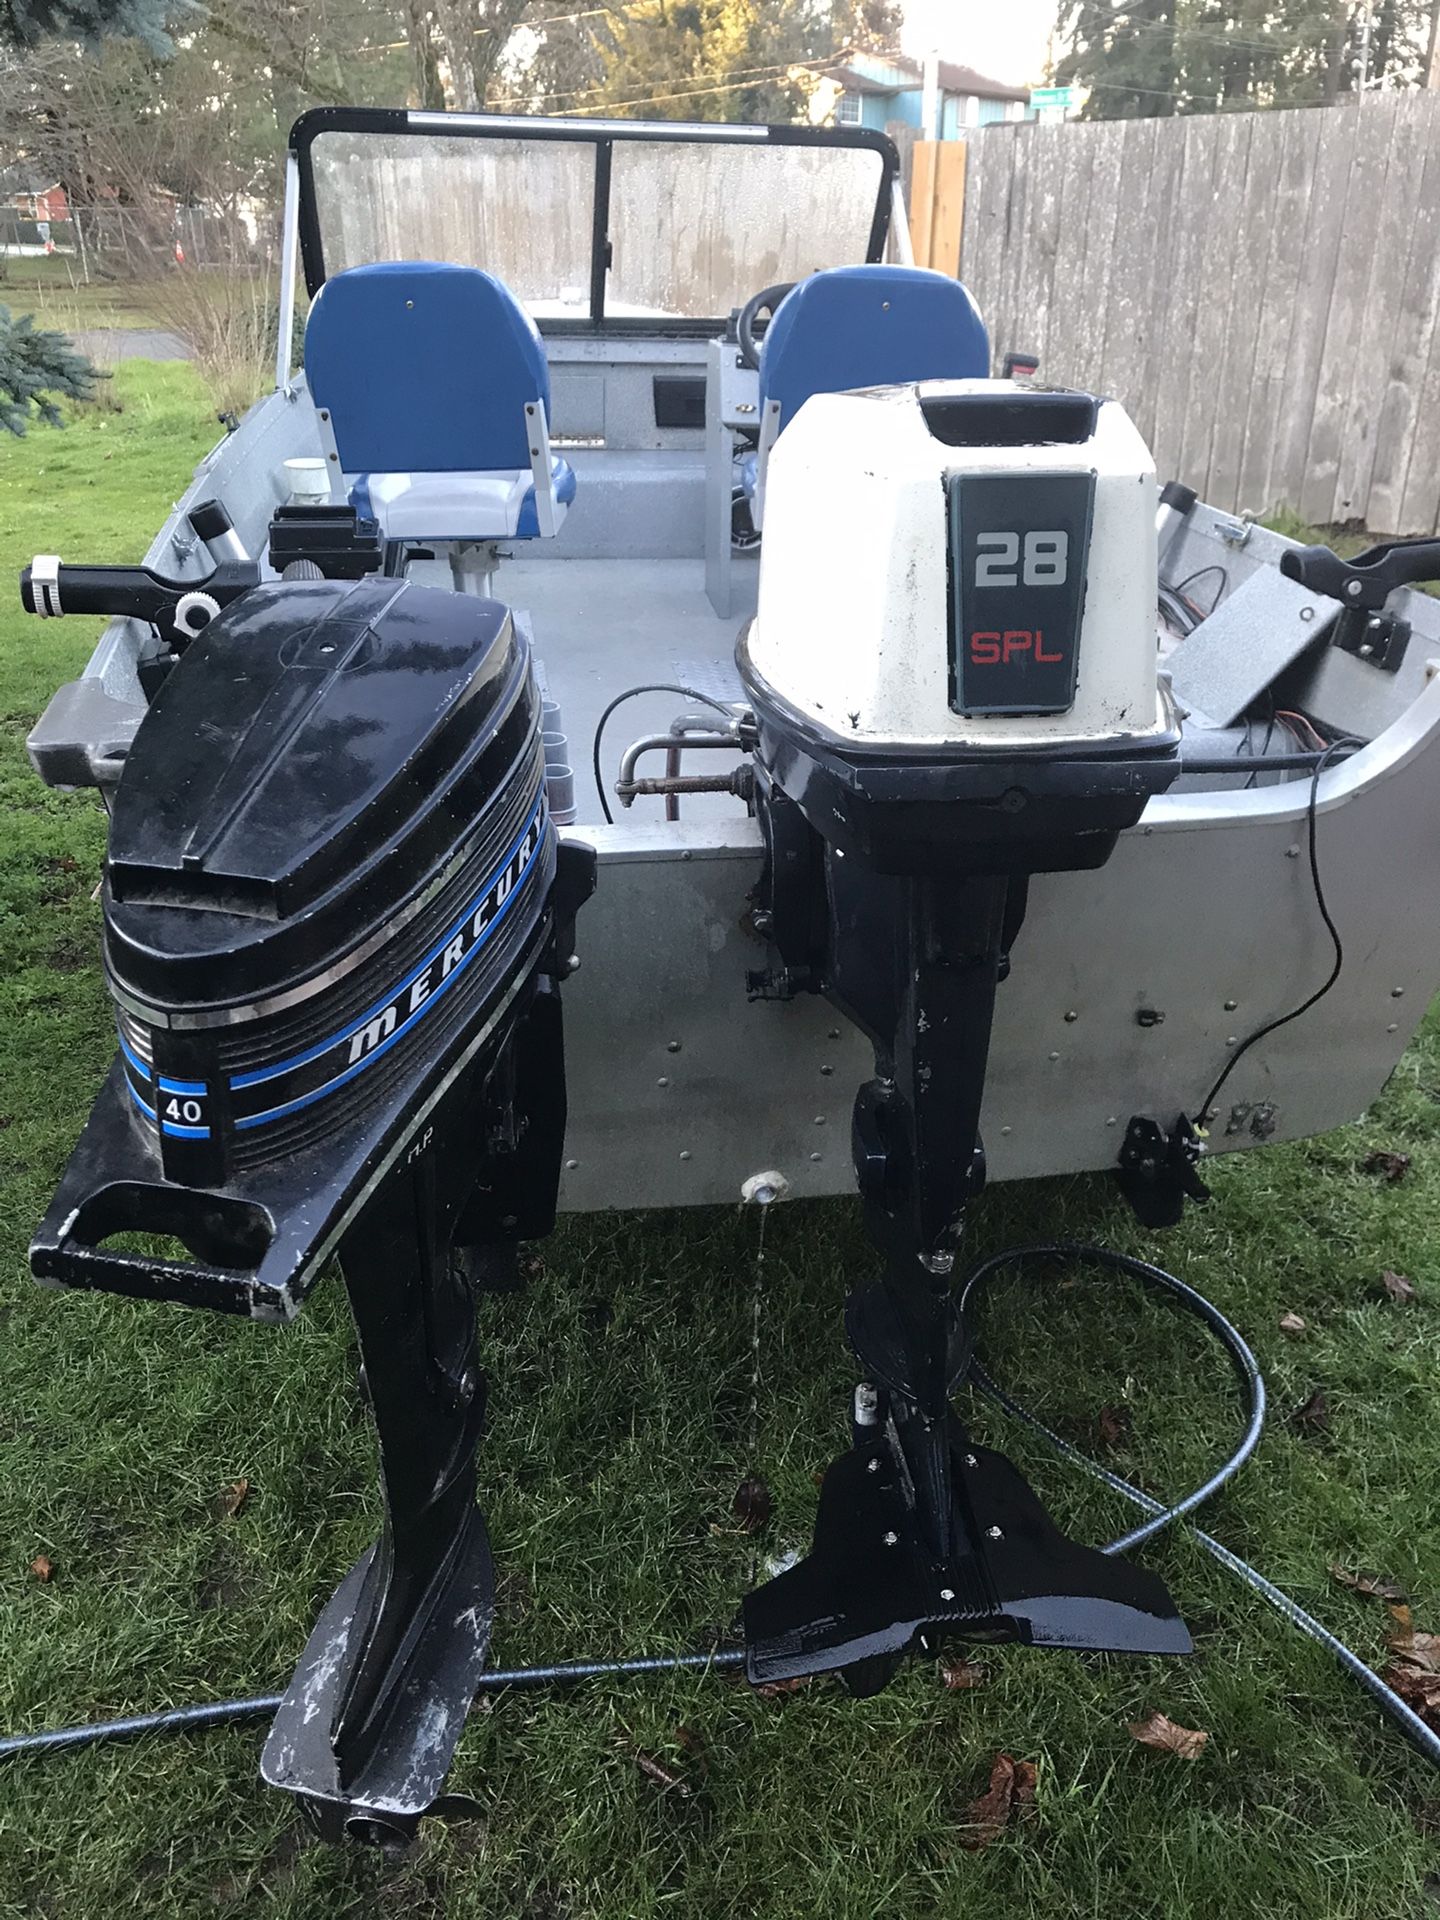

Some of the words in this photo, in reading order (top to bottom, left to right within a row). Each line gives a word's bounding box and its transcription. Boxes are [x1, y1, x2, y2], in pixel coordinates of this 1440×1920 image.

[975, 530, 1069, 587] 28
[971, 630, 1064, 665] SPL
[348, 803, 543, 1065] MERCURY
[165, 1098, 202, 1122] 40
